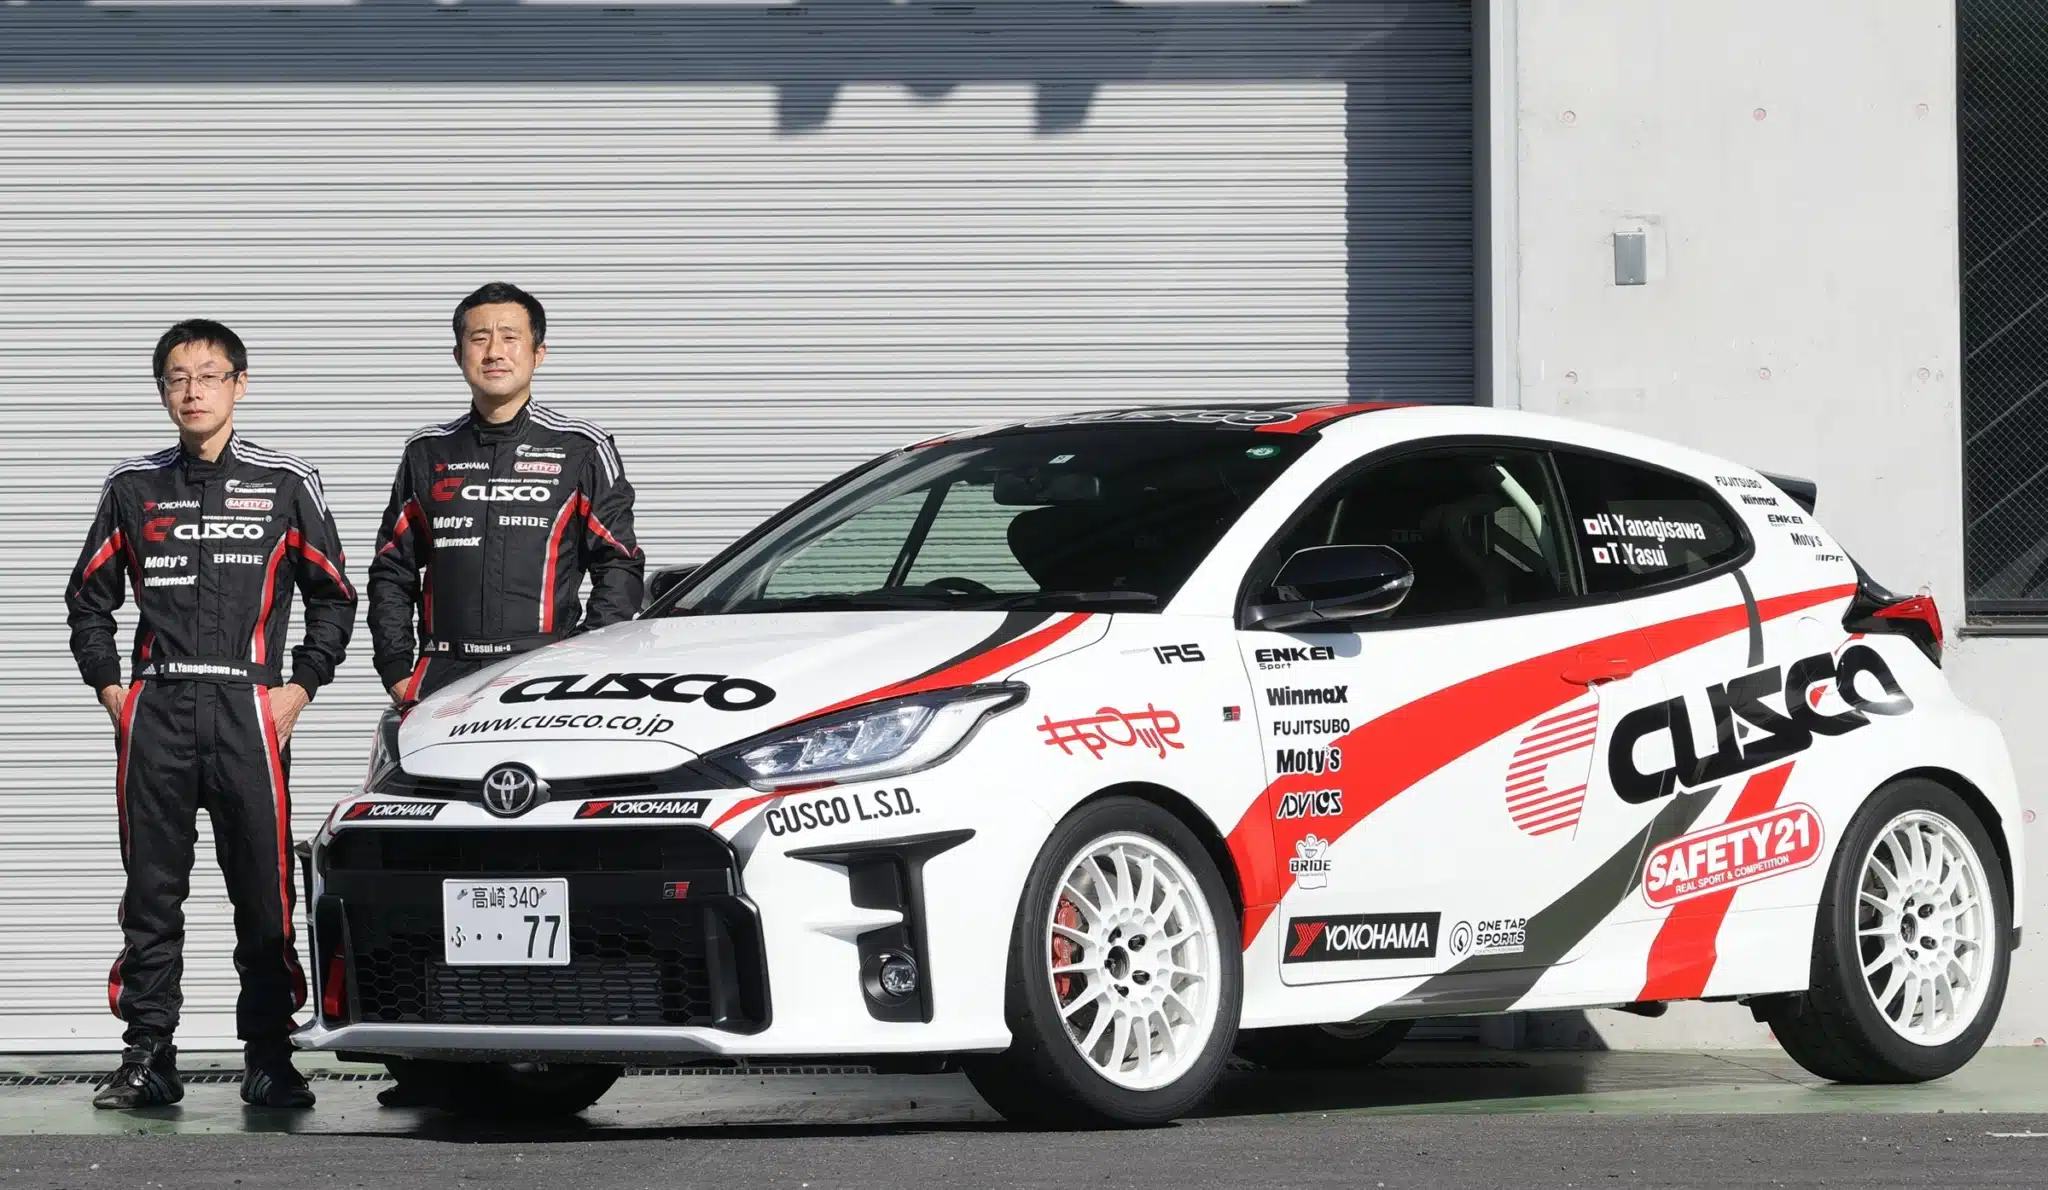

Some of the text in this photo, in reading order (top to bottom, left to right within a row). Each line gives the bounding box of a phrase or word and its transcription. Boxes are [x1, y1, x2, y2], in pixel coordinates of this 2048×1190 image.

[447, 462, 490, 471] YOKOHAMA
[1715, 476, 1762, 489] FUJITSUBO
[461, 485, 551, 502] CUSCO
[157, 500, 200, 510] YOKOHAMA
[433, 516, 473, 529] Moty's
[499, 516, 549, 528] BRIDE
[1767, 514, 1803, 524] ENKEI
[173, 523, 264, 540] CUSCO
[1597, 513, 1706, 542] H.Yanagisawa
[144, 555, 188, 569] Moty's
[213, 553, 263, 565] BRIDE
[464, 643, 493, 653] T.Yasui
[1153, 643, 1206, 664] IRS
[1255, 646, 1335, 663] ENKEI
[168, 662, 230, 674] H.Yanagisawa
[1259, 662, 1291, 670] Sport
[498, 672, 777, 712] CUSCO
[449, 713, 675, 737] www.cusco.co.jp
[1273, 718, 1350, 736] FUJITSUBO
[1608, 644, 1914, 805] CUSCO
[367, 804, 436, 816] YOKOHAMA
[610, 801, 699, 815] YOKOHAMA
[765, 787, 921, 837] CUSCO L.S.D.
[1290, 859, 1332, 872] BRIDE
[1675, 854, 1790, 894] REAL SPORT & COMPETITION
[472, 886, 540, 909] 高崎 340
[1478, 918, 1526, 932] ONE TAP
[523, 915, 561, 959] 77
[1325, 922, 1430, 952] YOKOHAMA
[1476, 931, 1525, 946] SPORTS
